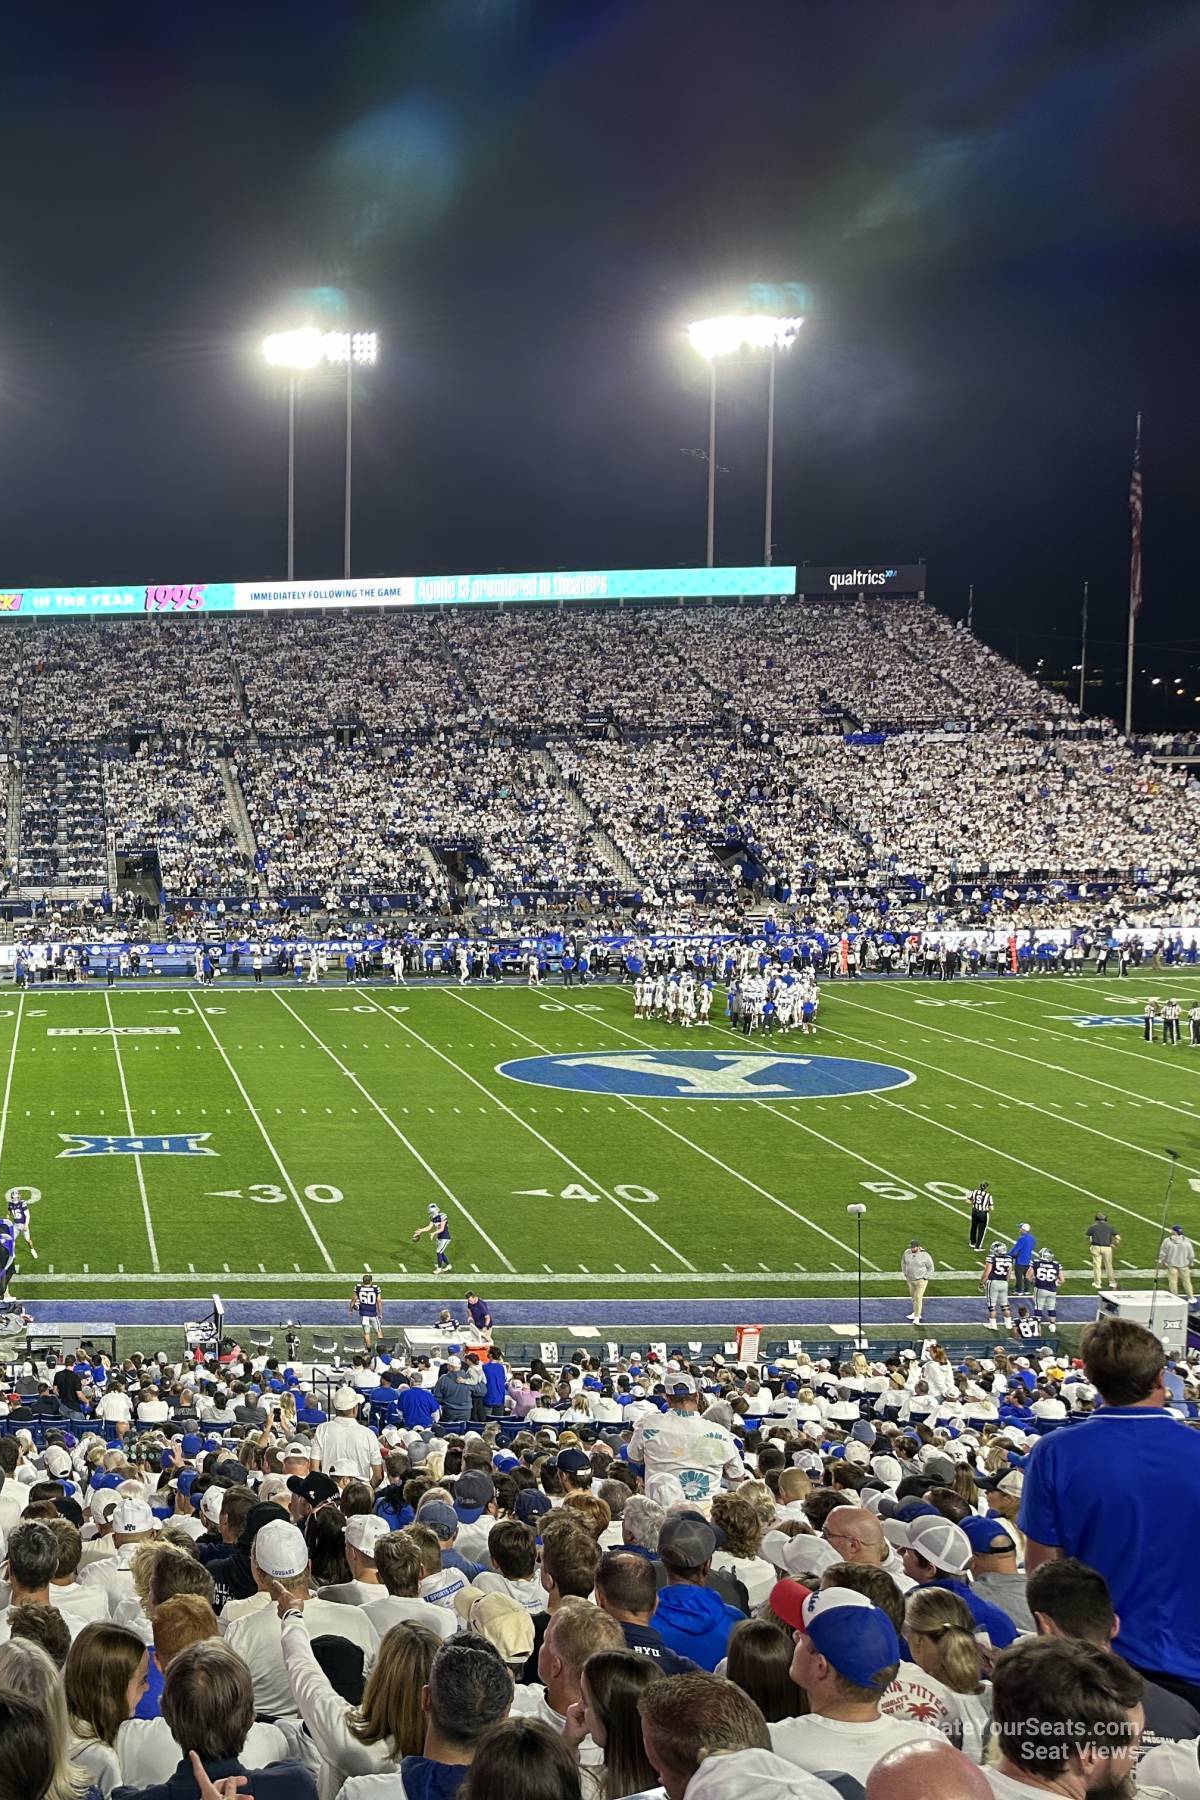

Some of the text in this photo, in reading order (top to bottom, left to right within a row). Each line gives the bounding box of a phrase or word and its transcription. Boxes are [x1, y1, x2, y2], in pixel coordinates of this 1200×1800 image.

[829, 569, 886, 591] qualtrics
[145, 584, 208, 611] 1995
[250, 587, 402, 601] IMMEDIATELY FOLLOWING THE GAME
[1036, 1267, 1057, 1282] 66
[358, 1291, 377, 1305] 60
[1018, 1320, 1040, 1338] 87
[429, 1589, 450, 1601] SPORTS
[633, 1645, 662, 1657] BYU
[908, 1682, 949, 1717] PITTED
